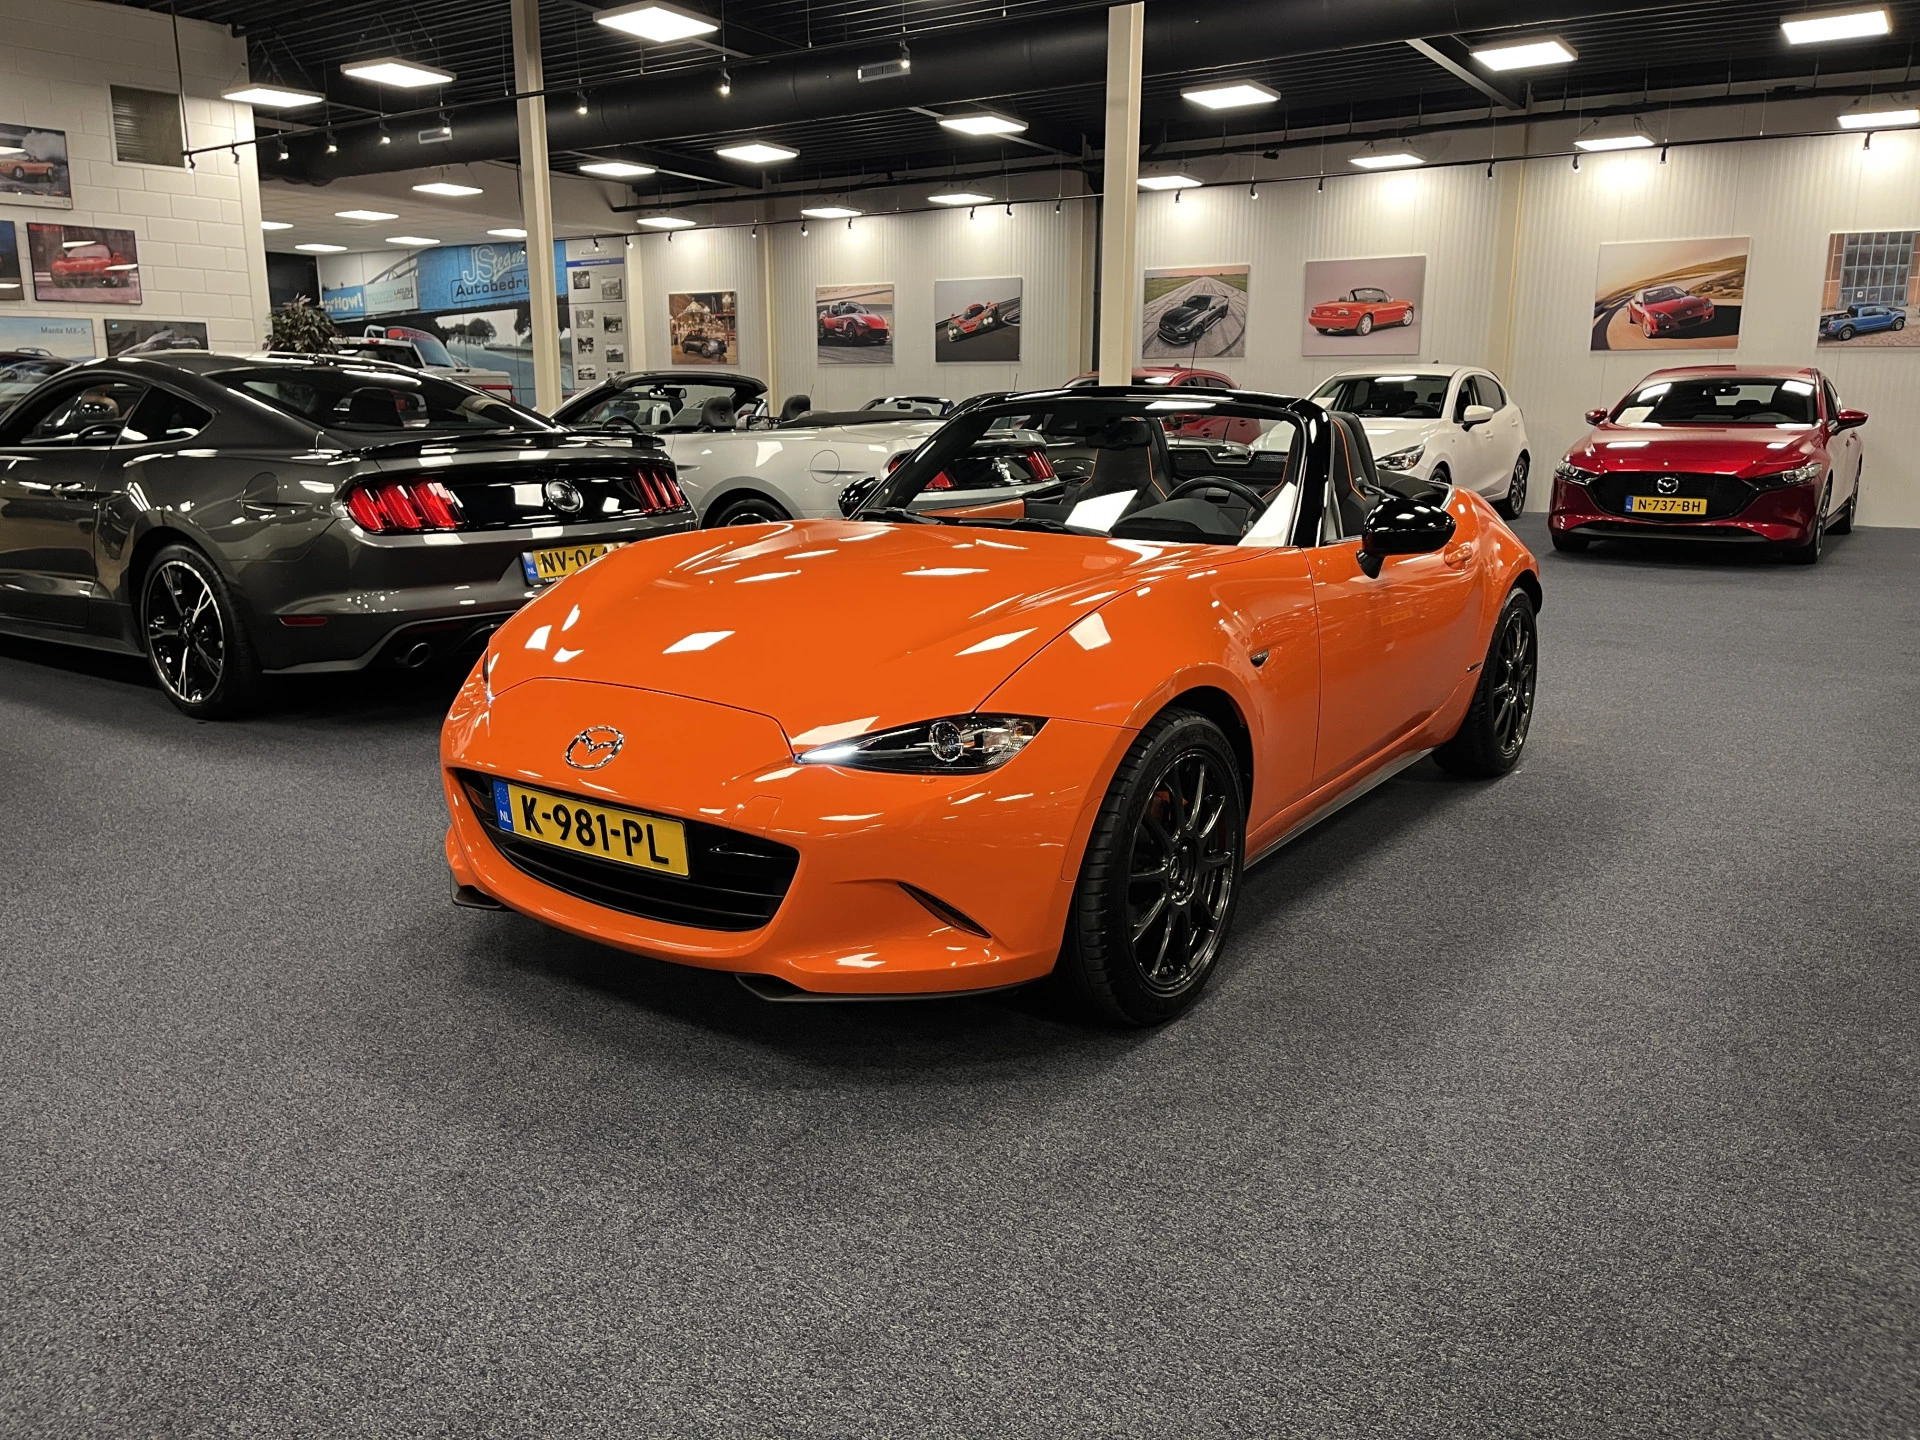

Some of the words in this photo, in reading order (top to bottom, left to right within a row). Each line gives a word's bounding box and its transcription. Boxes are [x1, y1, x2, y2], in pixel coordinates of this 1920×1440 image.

[456, 275, 530, 297] Autobedrij
[41, 326, 63, 335] Mazda
[66, 327, 86, 335] MX-5
[1638, 499, 1701, 512] N-737-BH
[499, 809, 512, 824] NL
[521, 794, 669, 865] K-981-PL
